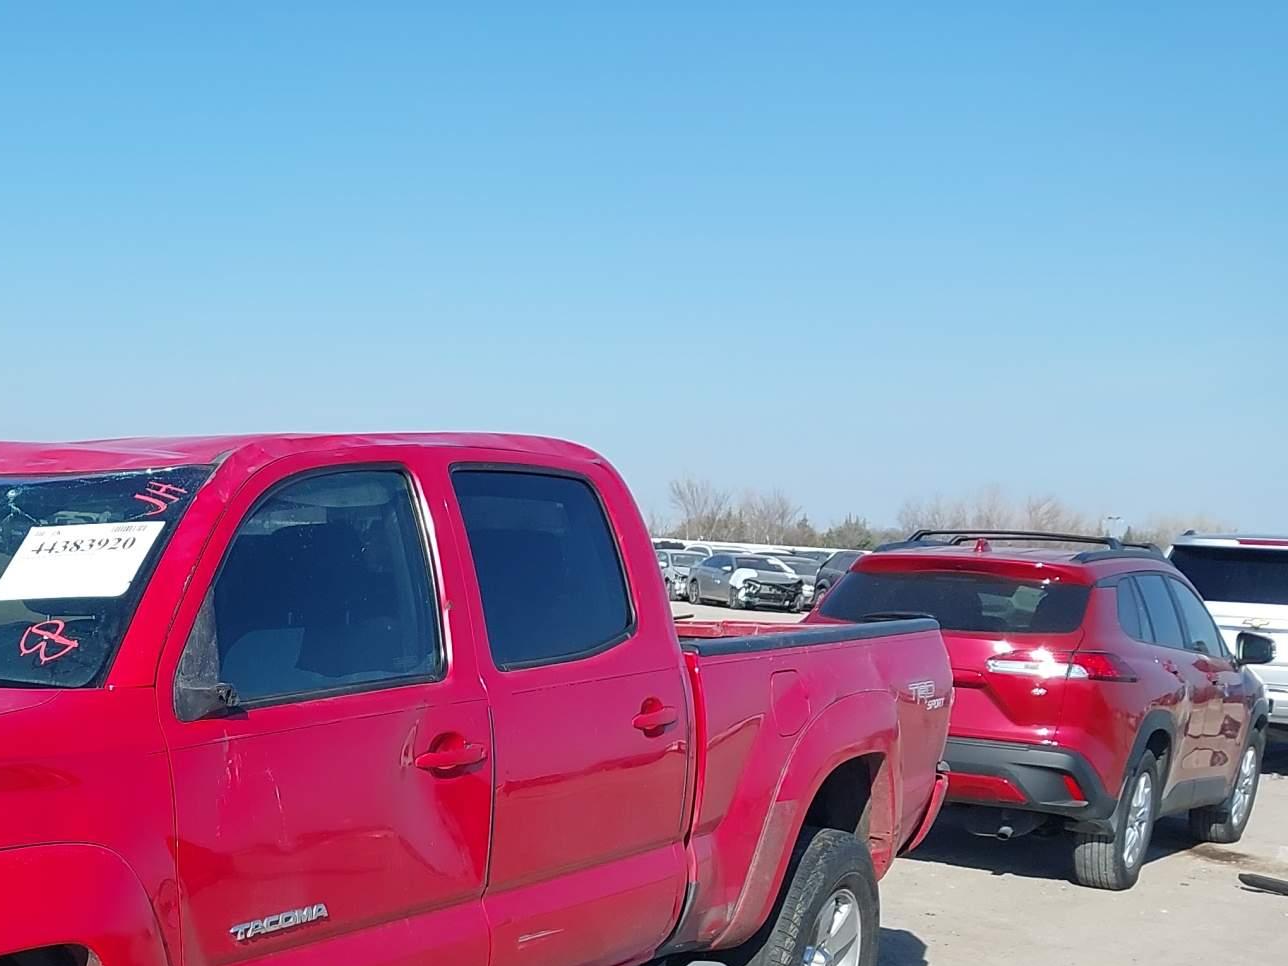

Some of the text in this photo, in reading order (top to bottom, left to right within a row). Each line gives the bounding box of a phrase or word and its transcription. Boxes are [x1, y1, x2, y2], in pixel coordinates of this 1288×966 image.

[31, 536, 137, 555] 44383920
[908, 680, 934, 705] TRD
[925, 697, 945, 711] SPORT
[229, 903, 328, 941] TACOMA
